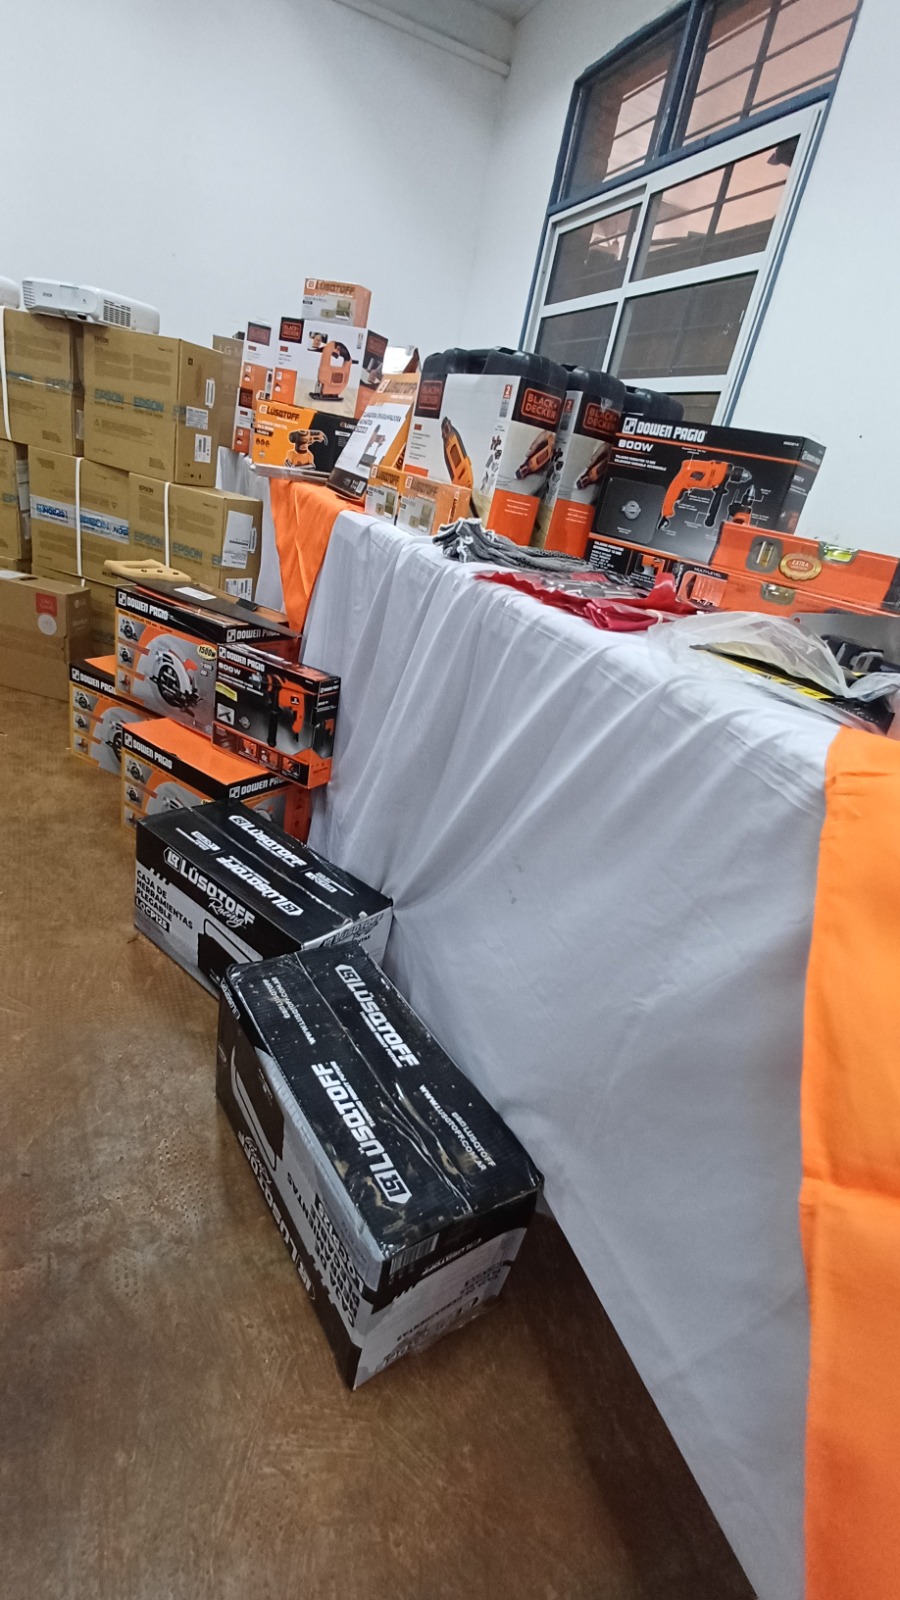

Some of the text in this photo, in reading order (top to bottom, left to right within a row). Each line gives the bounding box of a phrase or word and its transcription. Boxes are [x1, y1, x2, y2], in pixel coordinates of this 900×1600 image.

[505, 385, 511, 396] 2
[133, 396, 164, 413] EPSON
[525, 403, 557, 419] DECKER
[526, 393, 558, 409] BLACK+
[636, 421, 706, 443] DOWEN PAGIO
[618, 439, 653, 453] 800W
[139, 484, 154, 494] EPSON
[134, 530, 163, 548] EPSON
[172, 541, 203, 560] EPSON
[791, 559, 809, 568] EXTRA
[126, 596, 149, 614] DOWEN
[149, 604, 169, 621] PAGIO
[236, 629, 260, 640] DOWEN
[218, 662, 242, 676] 800W
[226, 650, 266, 673] DOWEN PAGIO
[79, 673, 100, 689] DOWEN
[133, 738, 173, 769] DOWEN PAGIO
[240, 778, 268, 796] DOWEN
[136, 869, 168, 900] CAJA DE
[136, 878, 193, 930] HERRAMIENTAS
[136, 887, 173, 922] PLEGABLE
[208, 896, 246, 928] Racing
[311, 1063, 392, 1181] LÜSQTOFF
[418, 1083, 488, 1172] WWW.LUSQTOFF.COM.AR
[287, 1171, 358, 1319] HERRAMIENTAS
[310, 1204, 360, 1309] PLEGABLE
[313, 1240, 356, 1329] CAJA DE
